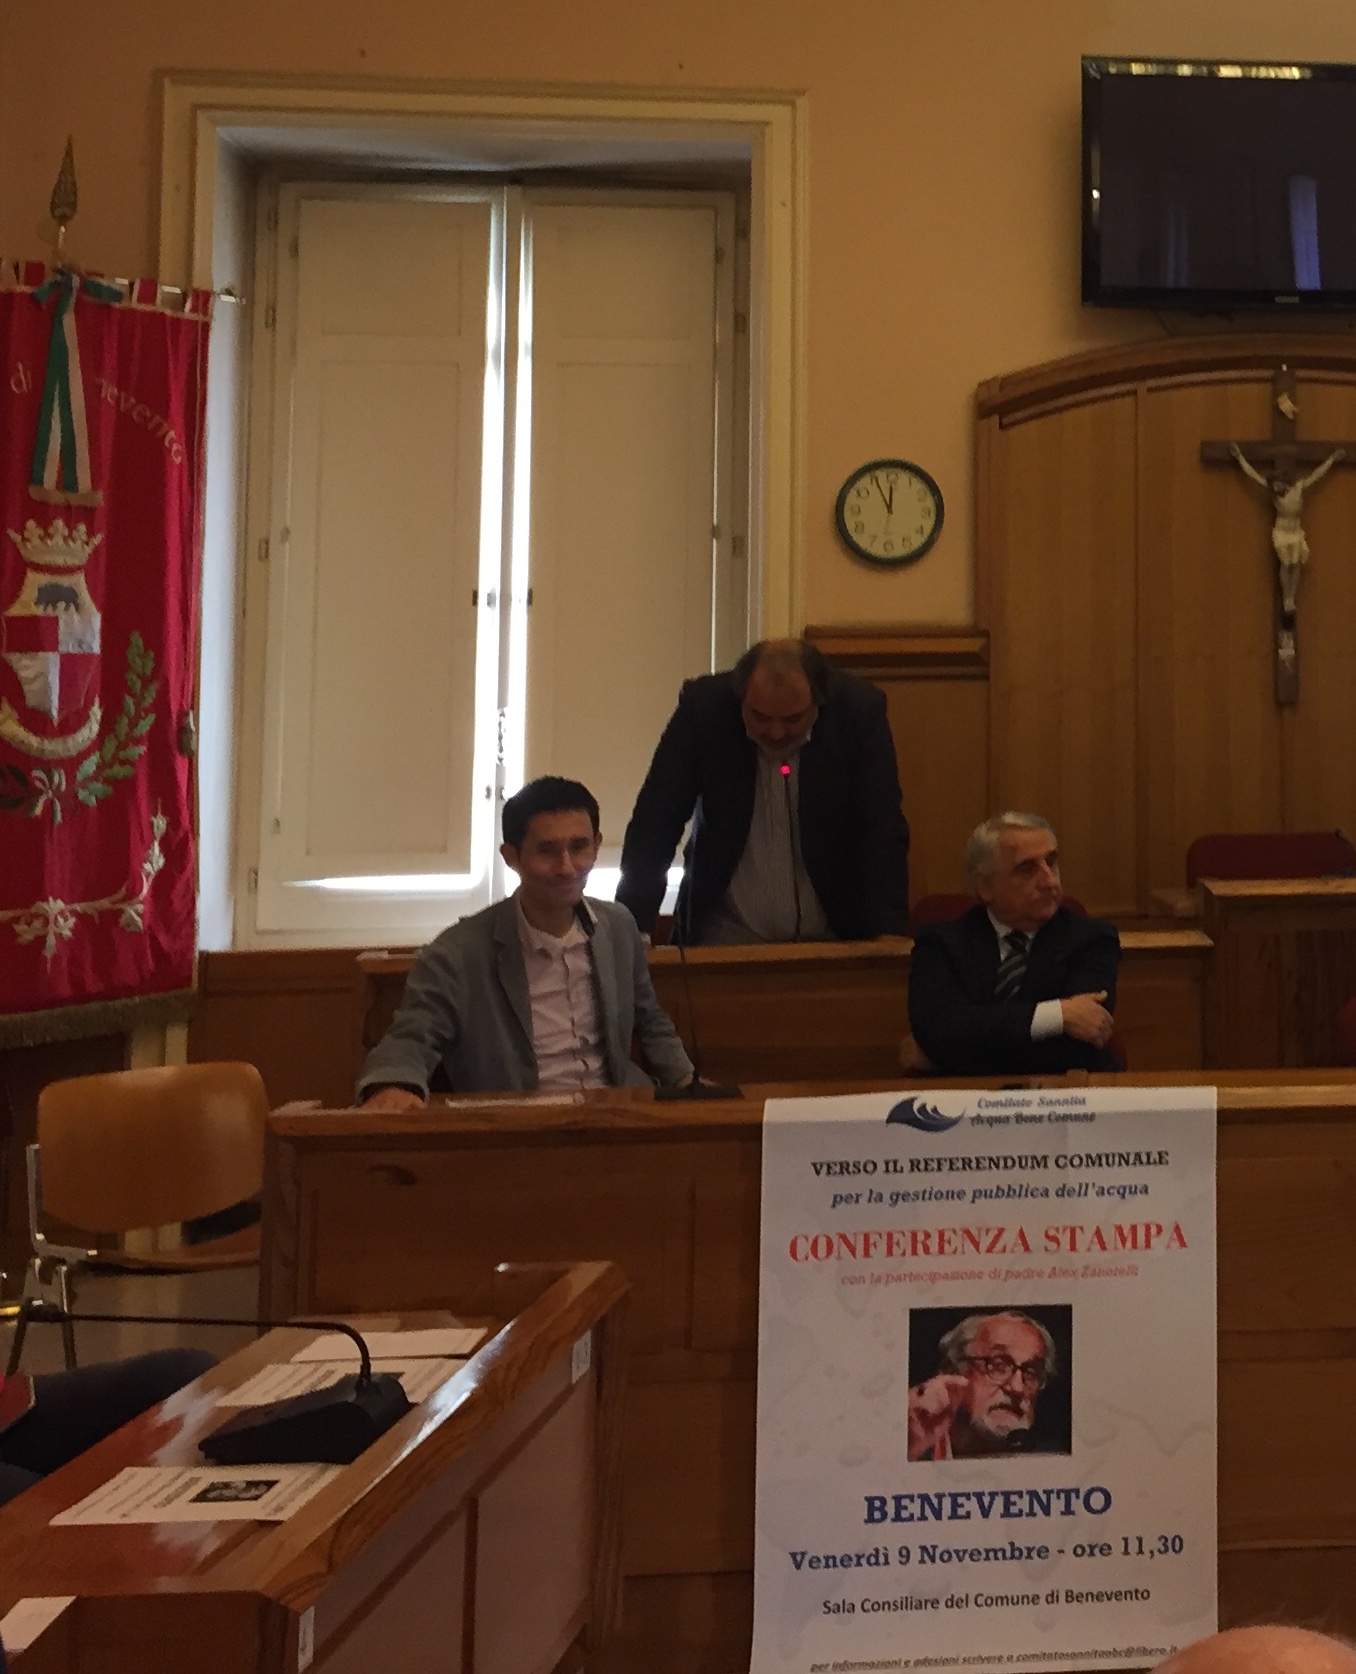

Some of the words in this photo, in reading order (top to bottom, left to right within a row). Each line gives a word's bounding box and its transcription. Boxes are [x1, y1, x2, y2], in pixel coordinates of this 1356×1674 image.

[811, 1158, 878, 1177] VERSO
[883, 1158, 904, 1174] IL
[908, 1154, 1049, 1173] REFERENDUM
[1054, 1150, 1170, 1169] COMUNALE
[830, 1190, 862, 1209] per
[867, 1186, 885, 1204] la
[889, 1186, 967, 1208] gestione
[970, 1183, 1050, 1204] pubblica
[1055, 1181, 1149, 1202] dell'acqua
[788, 1225, 1034, 1263] CONFERENZA
[1043, 1220, 1188, 1254] STAMPA
[863, 1486, 1113, 1524] BENEVENTO
[788, 1547, 890, 1571] Venerdì
[898, 1546, 912, 1566] 9
[917, 1541, 1050, 1566] Novembre
[1072, 1540, 1112, 1560] ore
[1120, 1534, 1185, 1561] 11,30
[822, 1599, 855, 1615] Sala
[860, 1595, 940, 1614] Consiliare
[944, 1593, 969, 1610] del
[973, 1590, 1040, 1609] Comune
[1044, 1589, 1060, 1606] di
[1064, 1586, 1151, 1605] Benevento
[810, 1661, 830, 1674] per
[832, 1657, 902, 1673] informazioni
[961, 1653, 1004, 1665] scrivere
